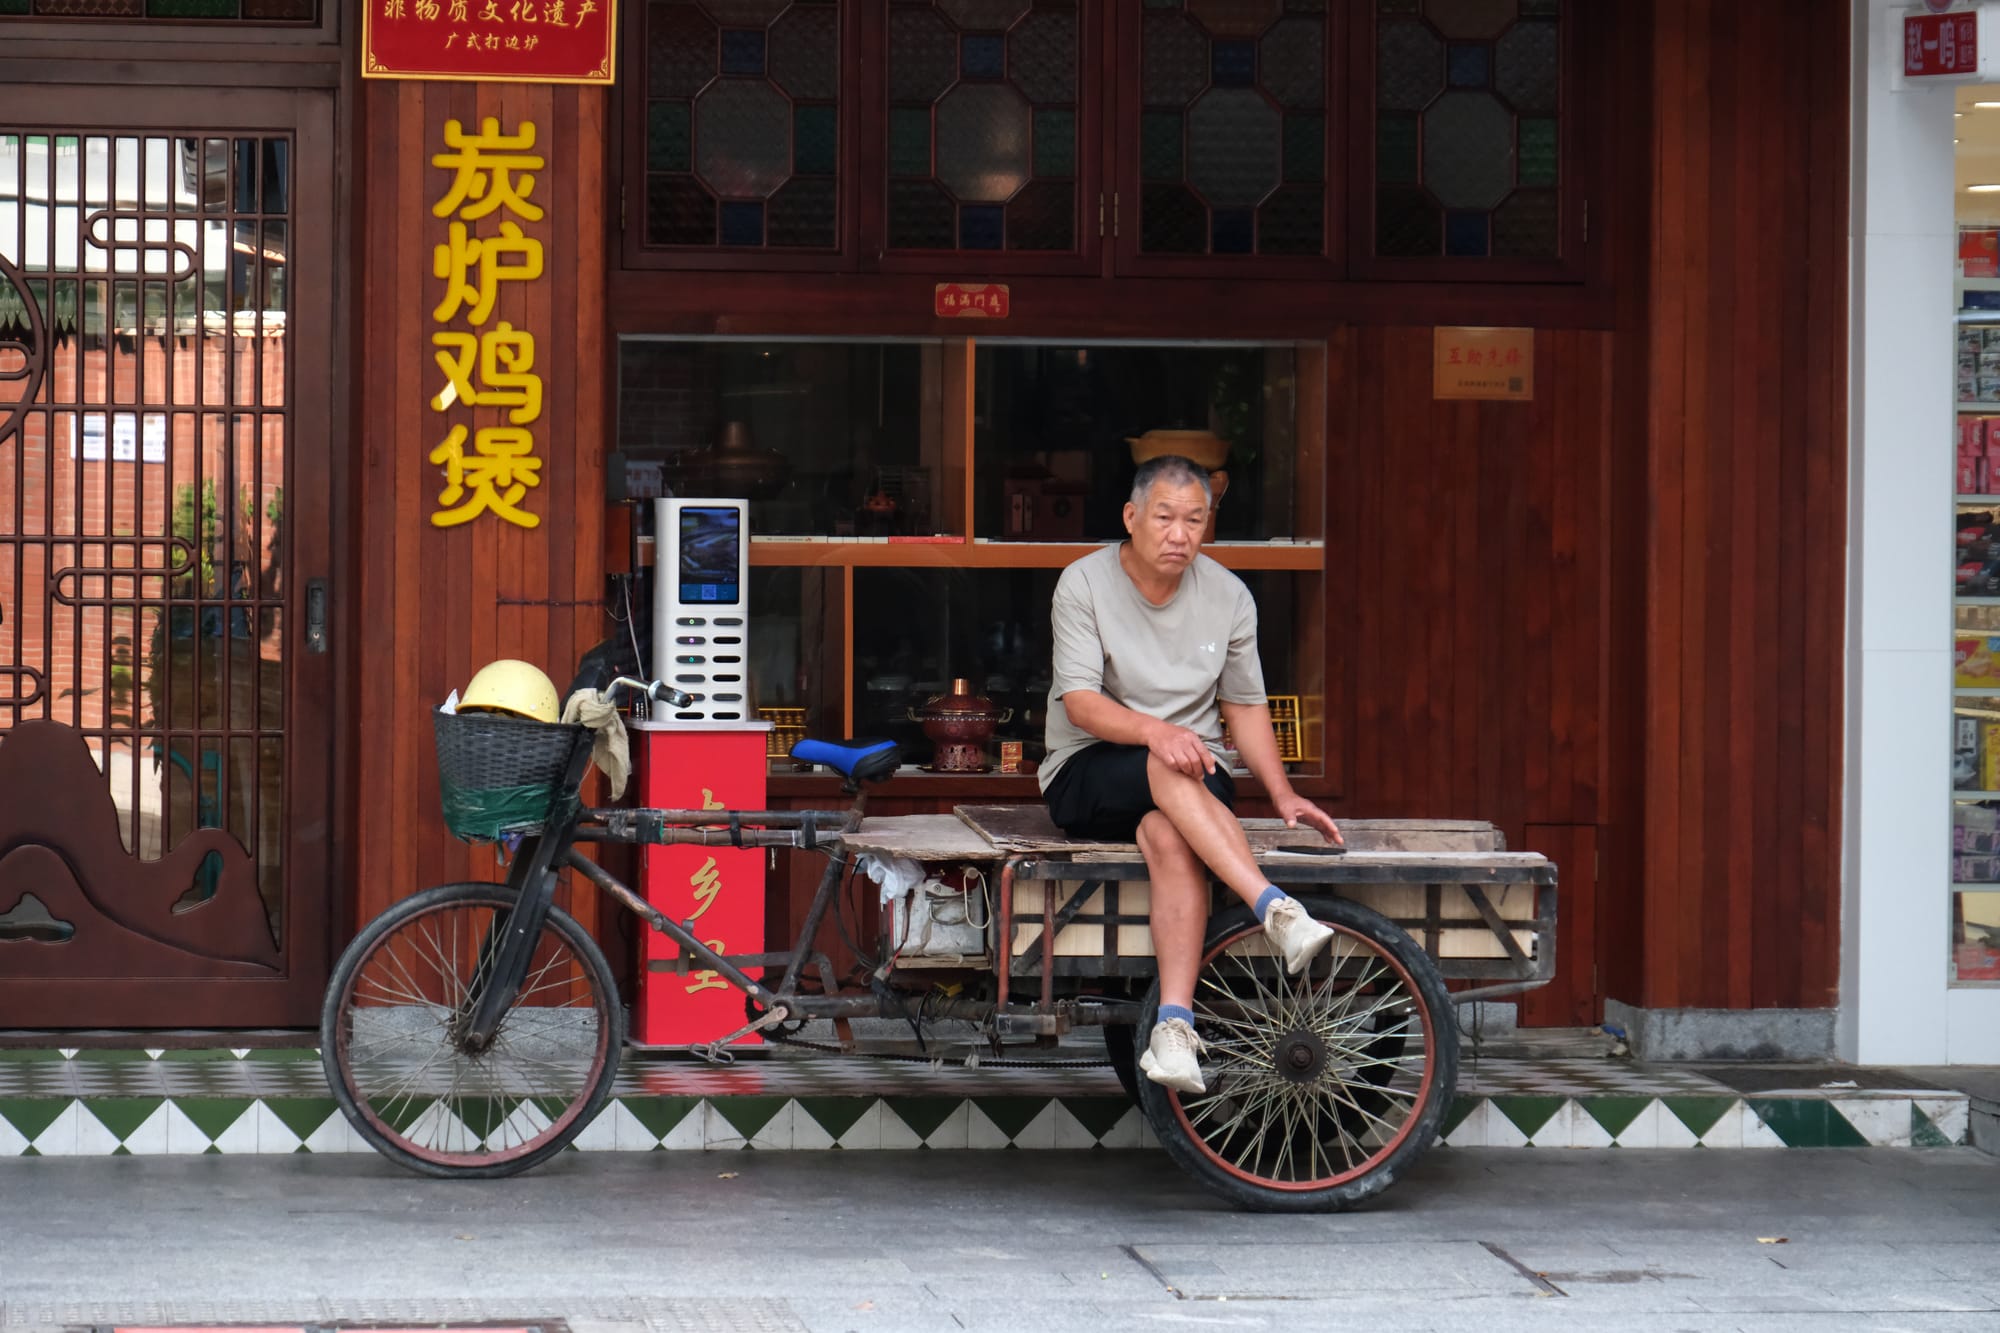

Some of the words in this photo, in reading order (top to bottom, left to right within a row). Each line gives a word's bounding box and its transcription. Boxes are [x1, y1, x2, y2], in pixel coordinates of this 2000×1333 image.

[444, 32, 540, 51] 广式打边炉
[429, 116, 545, 530] 炭炉鸡煲
